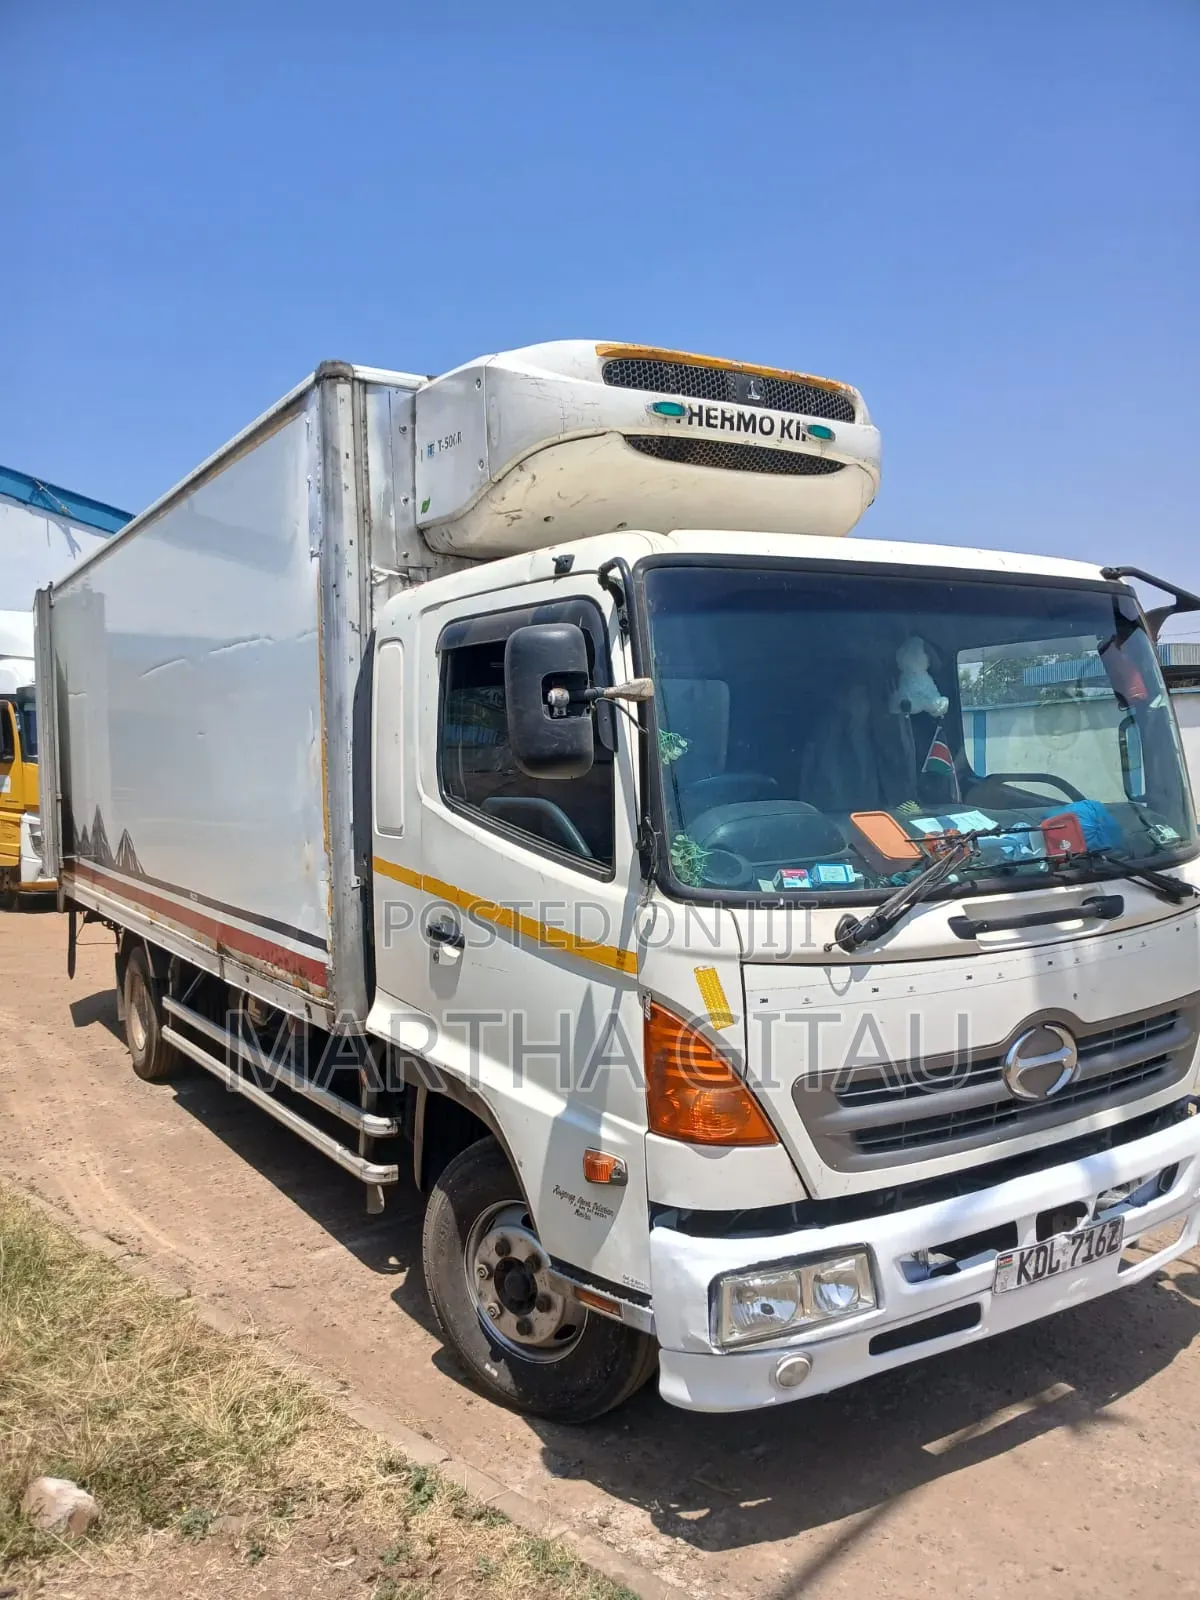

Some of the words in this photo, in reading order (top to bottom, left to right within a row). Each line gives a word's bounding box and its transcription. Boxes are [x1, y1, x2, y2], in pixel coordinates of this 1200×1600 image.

[676, 404, 775, 437] HERMO
[1017, 1242, 1060, 1285] KDL
[1071, 1222, 1121, 1266] 716Z
